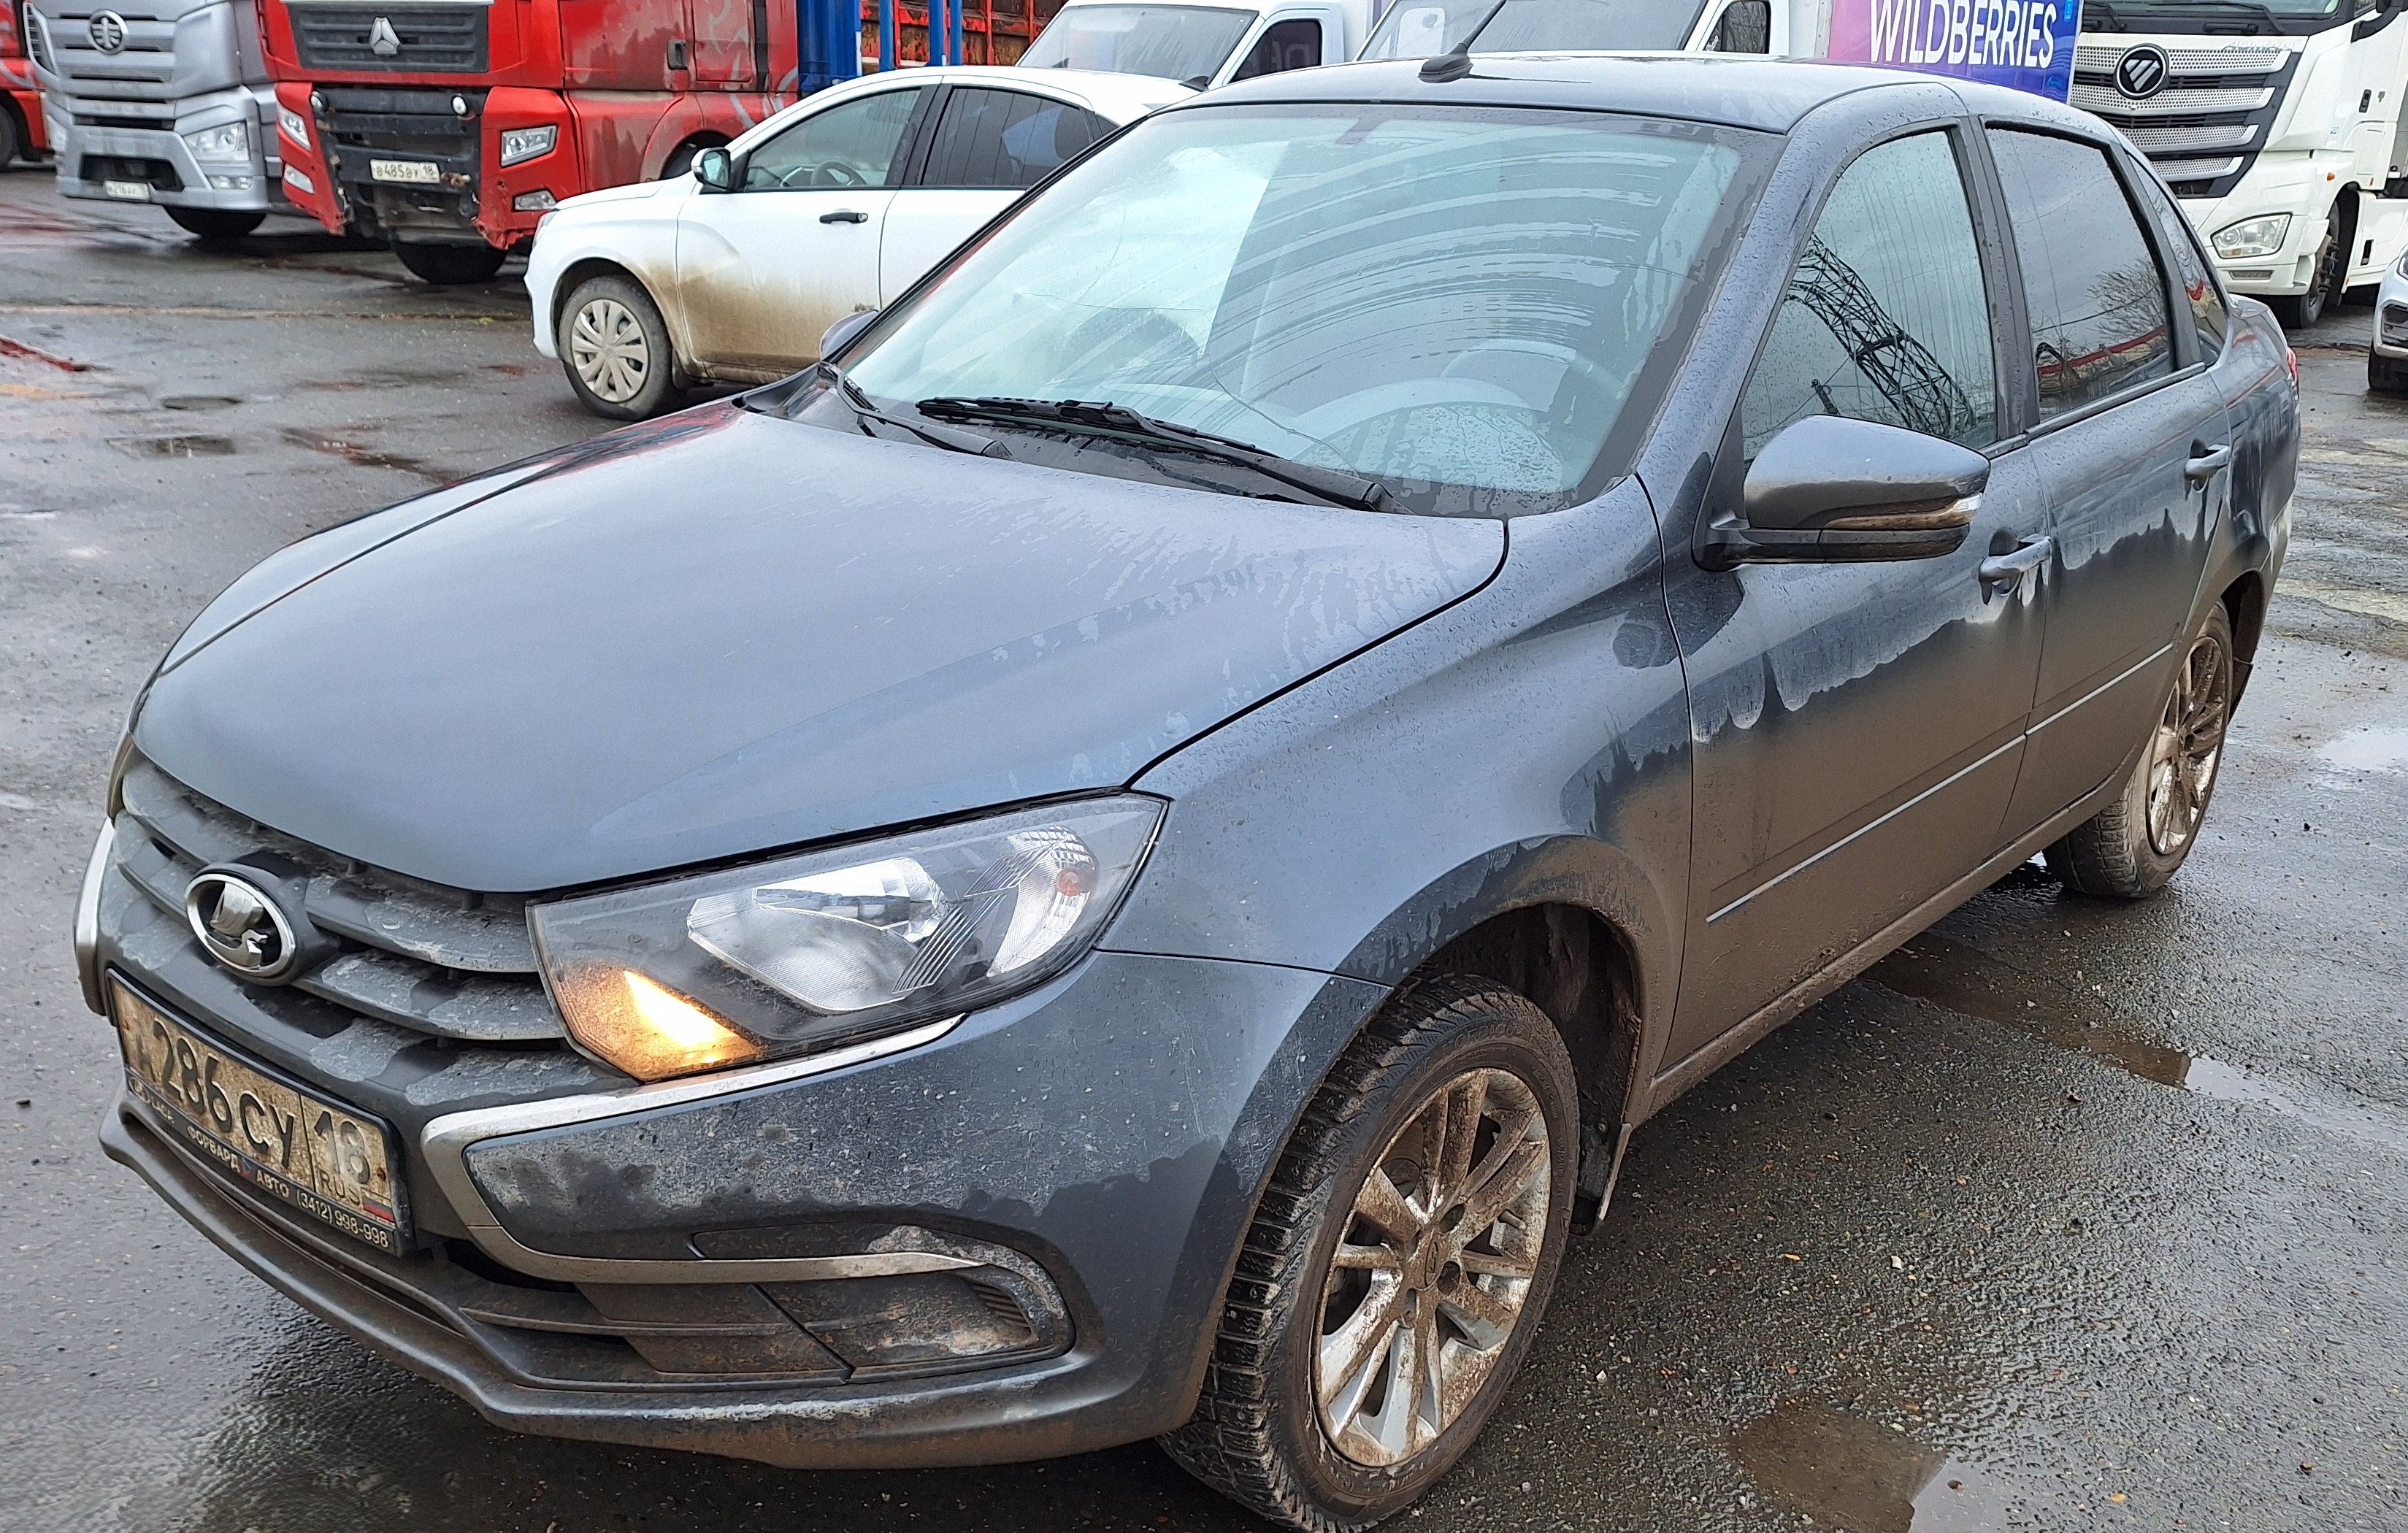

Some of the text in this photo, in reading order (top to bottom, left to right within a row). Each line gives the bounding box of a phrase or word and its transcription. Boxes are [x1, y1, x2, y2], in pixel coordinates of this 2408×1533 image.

[1871, 0, 2057, 69] WILDBERRIES
[314, 1110, 371, 1185] 18
[188, 1125, 389, 1248] ФОРВАРД АВТО (3412) 998-998
[318, 1169, 361, 1207] RUS
